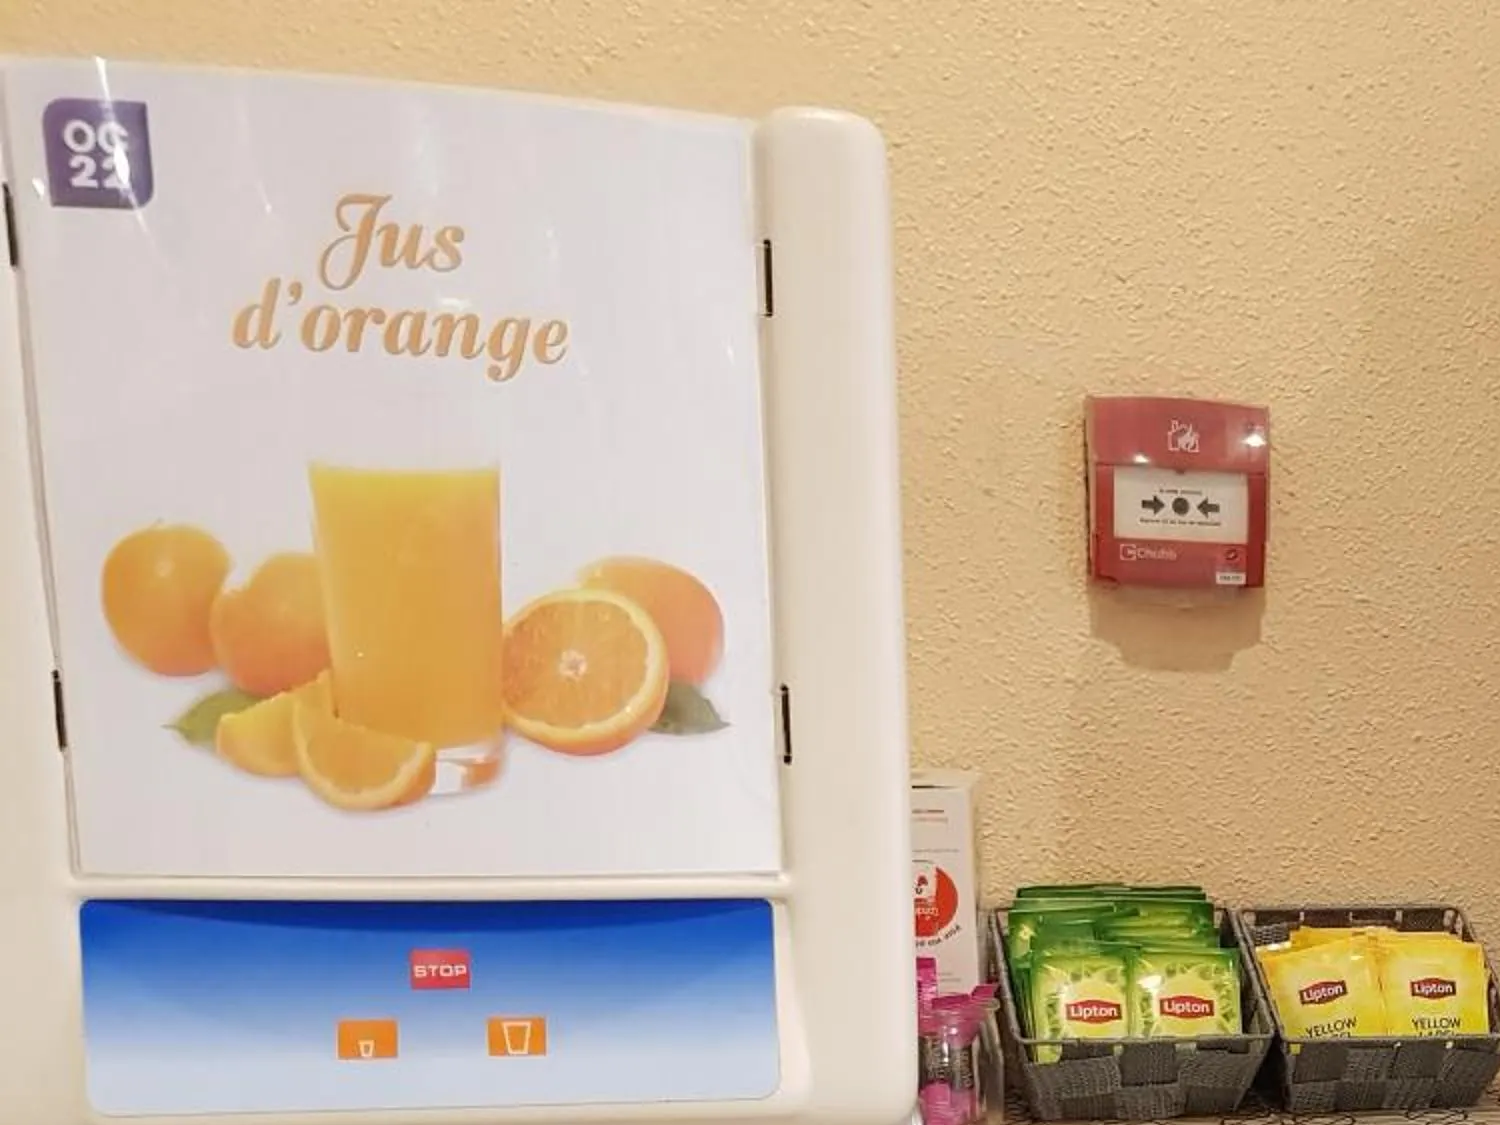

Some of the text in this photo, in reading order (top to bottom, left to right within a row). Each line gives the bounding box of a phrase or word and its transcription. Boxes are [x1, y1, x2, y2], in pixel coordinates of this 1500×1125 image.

[319, 193, 465, 290] Jus
[413, 964, 468, 978] STOP
[1302, 983, 1344, 1001] Lipton
[1414, 981, 1454, 995] Lipton
[1070, 1005, 1119, 1019] Lipton
[1163, 1000, 1211, 1014] Lipton
[1305, 1016, 1358, 1038] YELLOW
[1411, 1017, 1462, 1031] YELLOW
